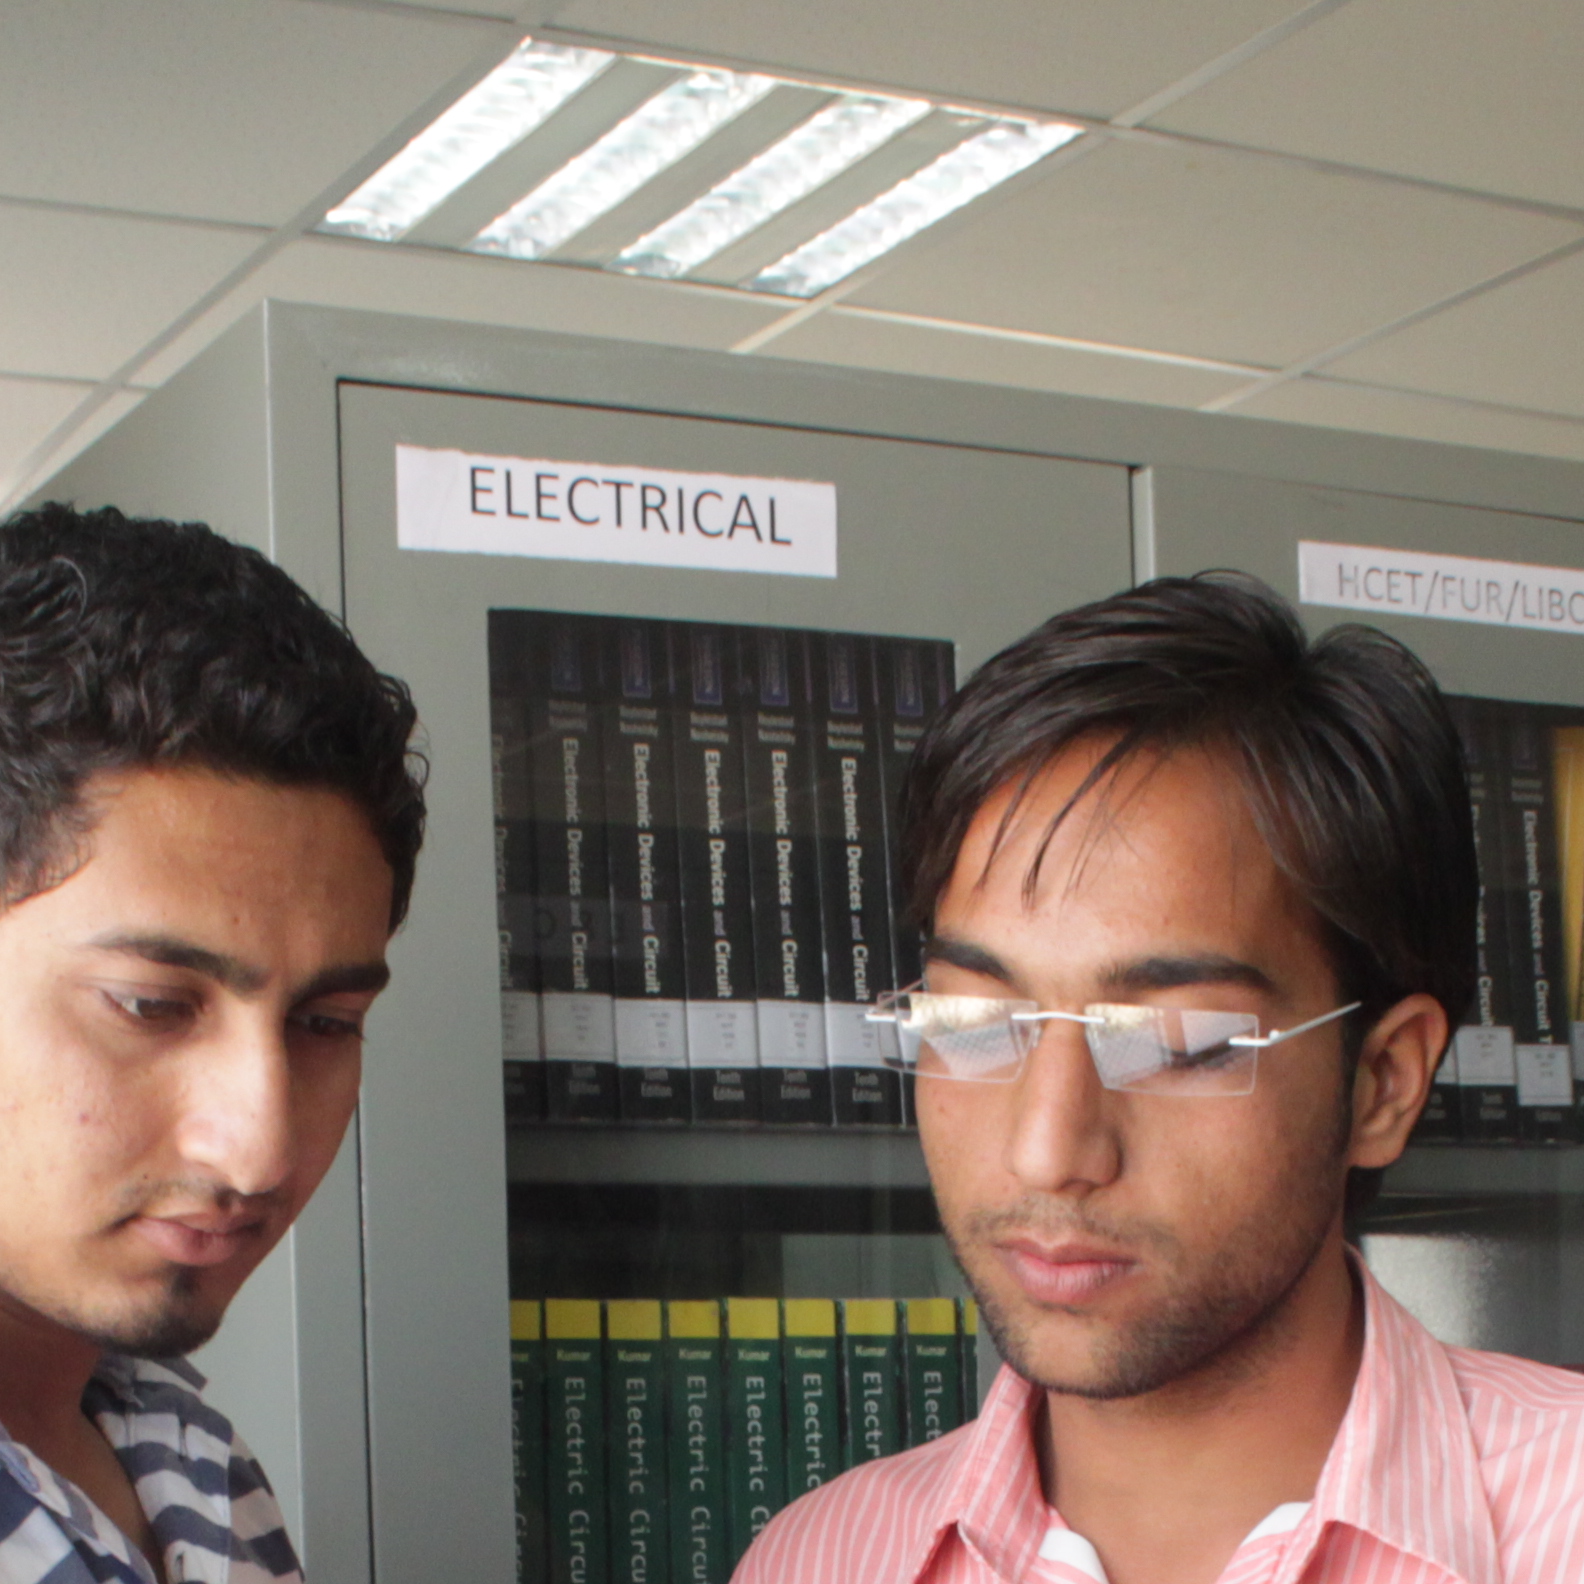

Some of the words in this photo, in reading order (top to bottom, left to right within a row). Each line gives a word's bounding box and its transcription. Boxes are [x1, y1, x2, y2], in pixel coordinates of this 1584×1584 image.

[469, 465, 793, 546] ELECTRICAL
[563, 737, 582, 822] Electronic
[633, 743, 653, 828] Electronic
[704, 750, 724, 834] Electronic
[772, 750, 791, 834] Electronic
[841, 757, 860, 841] Electronic
[567, 828, 585, 896] Devices
[638, 833, 656, 900] Devices
[709, 838, 728, 905] Devices
[776, 838, 794, 905] Devices
[846, 845, 864, 911] Devices
[1522, 810, 1539, 885] Electronic
[713, 909, 728, 935] and
[780, 909, 795, 935] and
[850, 915, 866, 940] and
[1528, 889, 1545, 949] Devices
[571, 931, 590, 989] Circuit
[643, 935, 662, 994] Circuit
[715, 940, 733, 998] Circuit
[782, 939, 800, 998] Circuit
[852, 944, 871, 1002] Circuit
[1534, 979, 1551, 1031] Circuit
[617, 1349, 652, 1364] Kumar
[678, 1347, 712, 1361] Kumar
[737, 1348, 770, 1362] Kumar
[794, 1346, 827, 1360] Kumar
[855, 1345, 887, 1358] Kumar
[916, 1345, 947, 1358] Kumar
[565, 1377, 585, 1495] Electric
[625, 1377, 646, 1494] Electric
[686, 1375, 707, 1492] Electric
[745, 1375, 766, 1491] Electric
[802, 1372, 822, 1487] Electric
